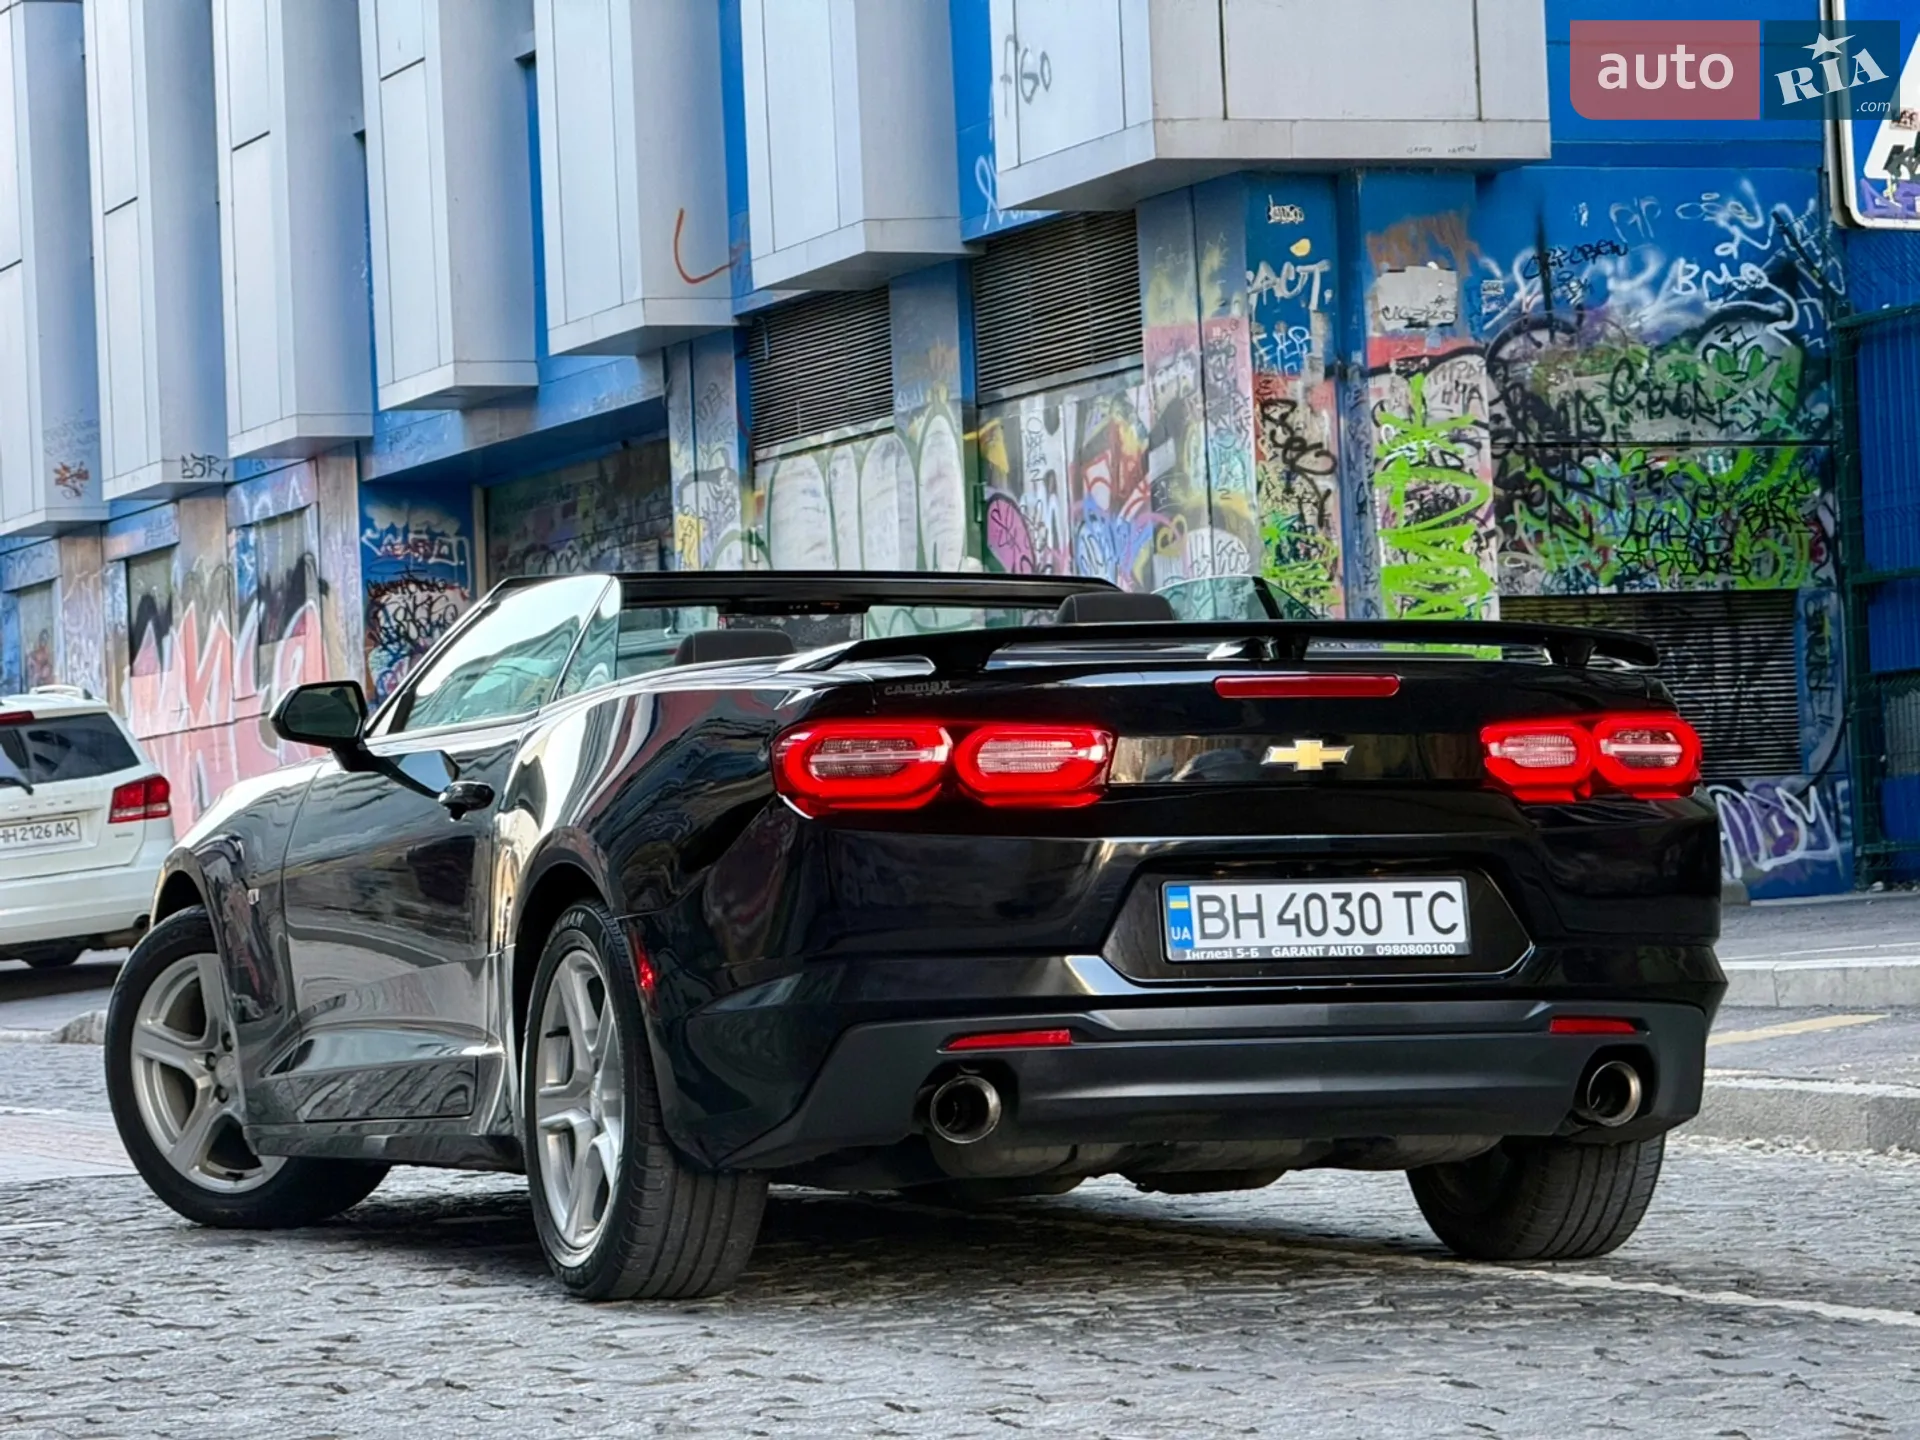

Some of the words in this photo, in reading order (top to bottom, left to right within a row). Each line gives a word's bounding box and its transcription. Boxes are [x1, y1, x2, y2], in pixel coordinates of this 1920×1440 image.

[20, 823, 52, 842] 2126
[55, 821, 76, 837] AK
[1196, 893, 1266, 940] BH
[1276, 892, 1383, 938] 4030
[1392, 890, 1459, 936] TC
[1171, 926, 1192, 940] UA
[1271, 946, 1325, 958] GARANT
[1328, 945, 1364, 956] AUTO
[1375, 944, 1456, 955] 0980800100
